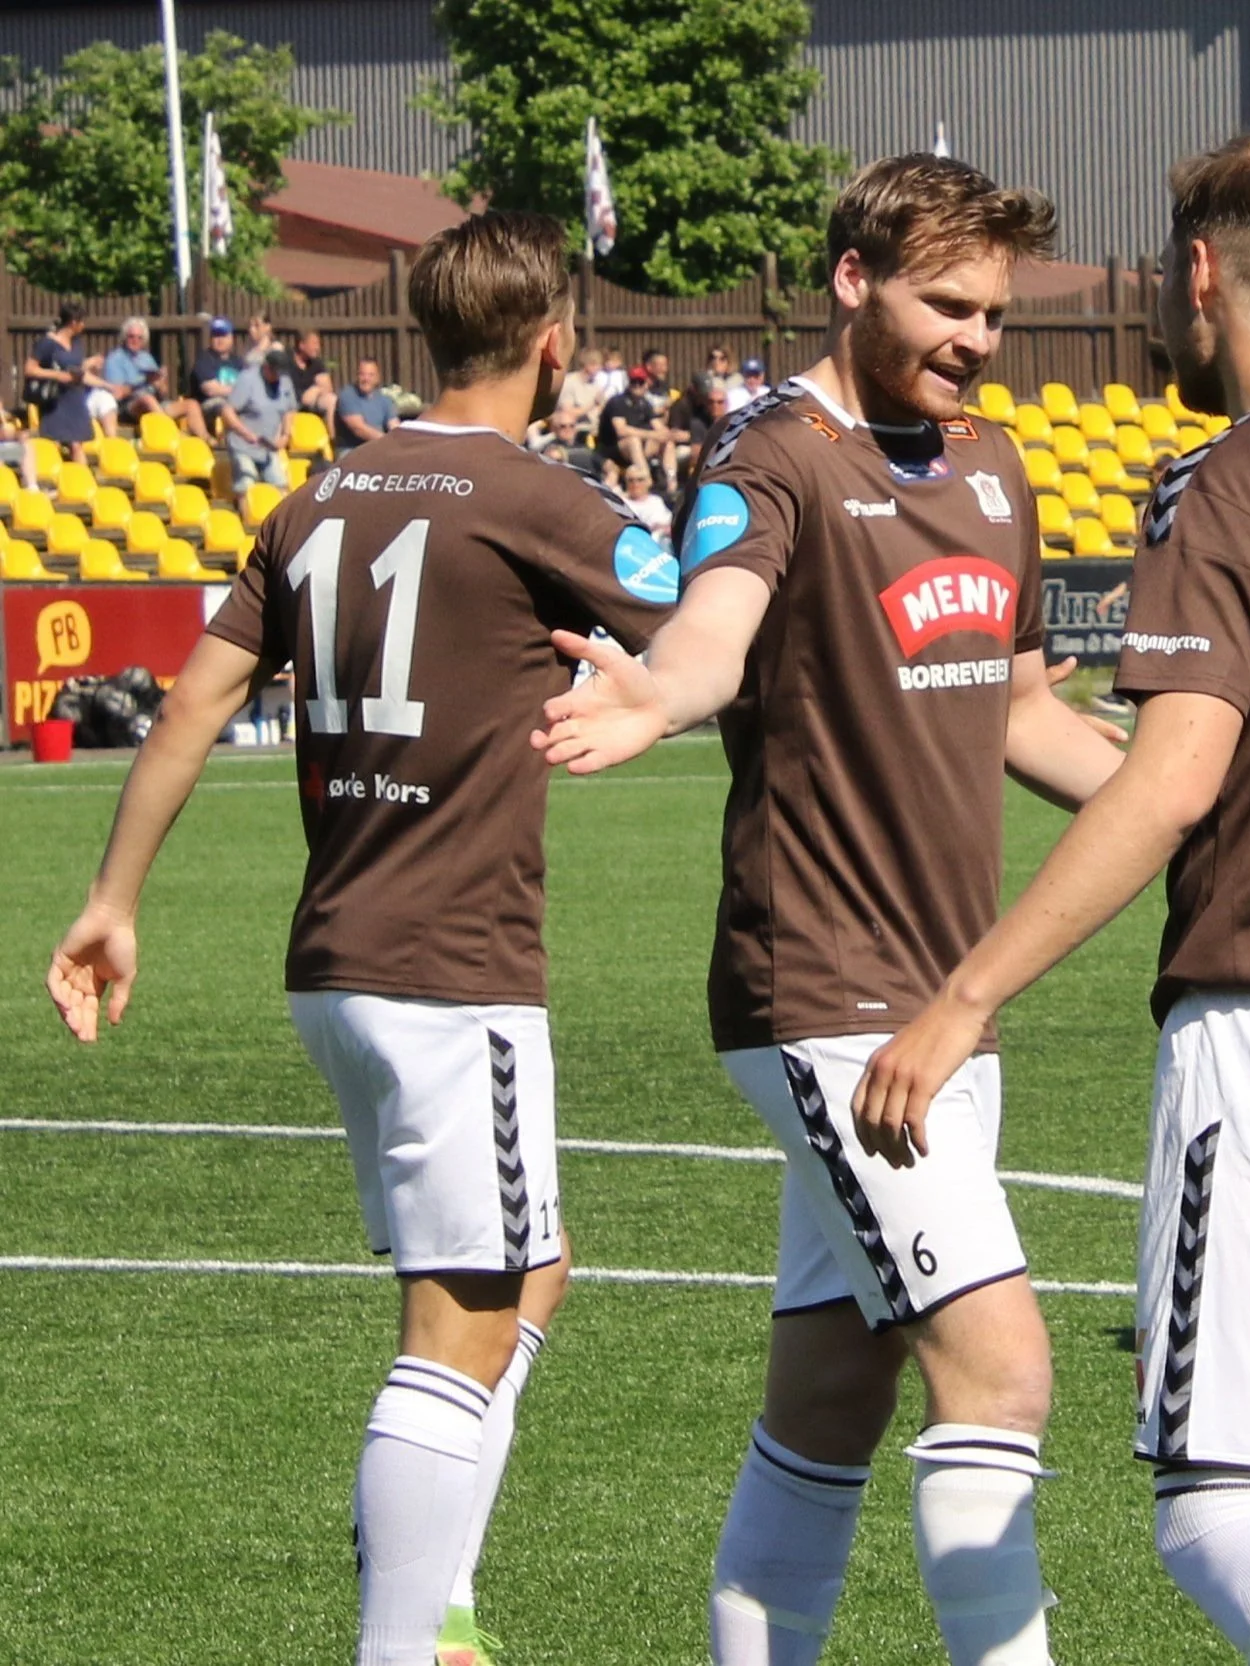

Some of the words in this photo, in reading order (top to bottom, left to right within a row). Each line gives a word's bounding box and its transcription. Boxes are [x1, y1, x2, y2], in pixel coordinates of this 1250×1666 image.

[340, 472, 383, 492] ABC
[384, 474, 473, 496] ELEKTRO
[902, 573, 1010, 632] MENY
[51, 613, 79, 656] PB
[286, 518, 430, 737] 11
[912, 1231, 937, 1277] 6
